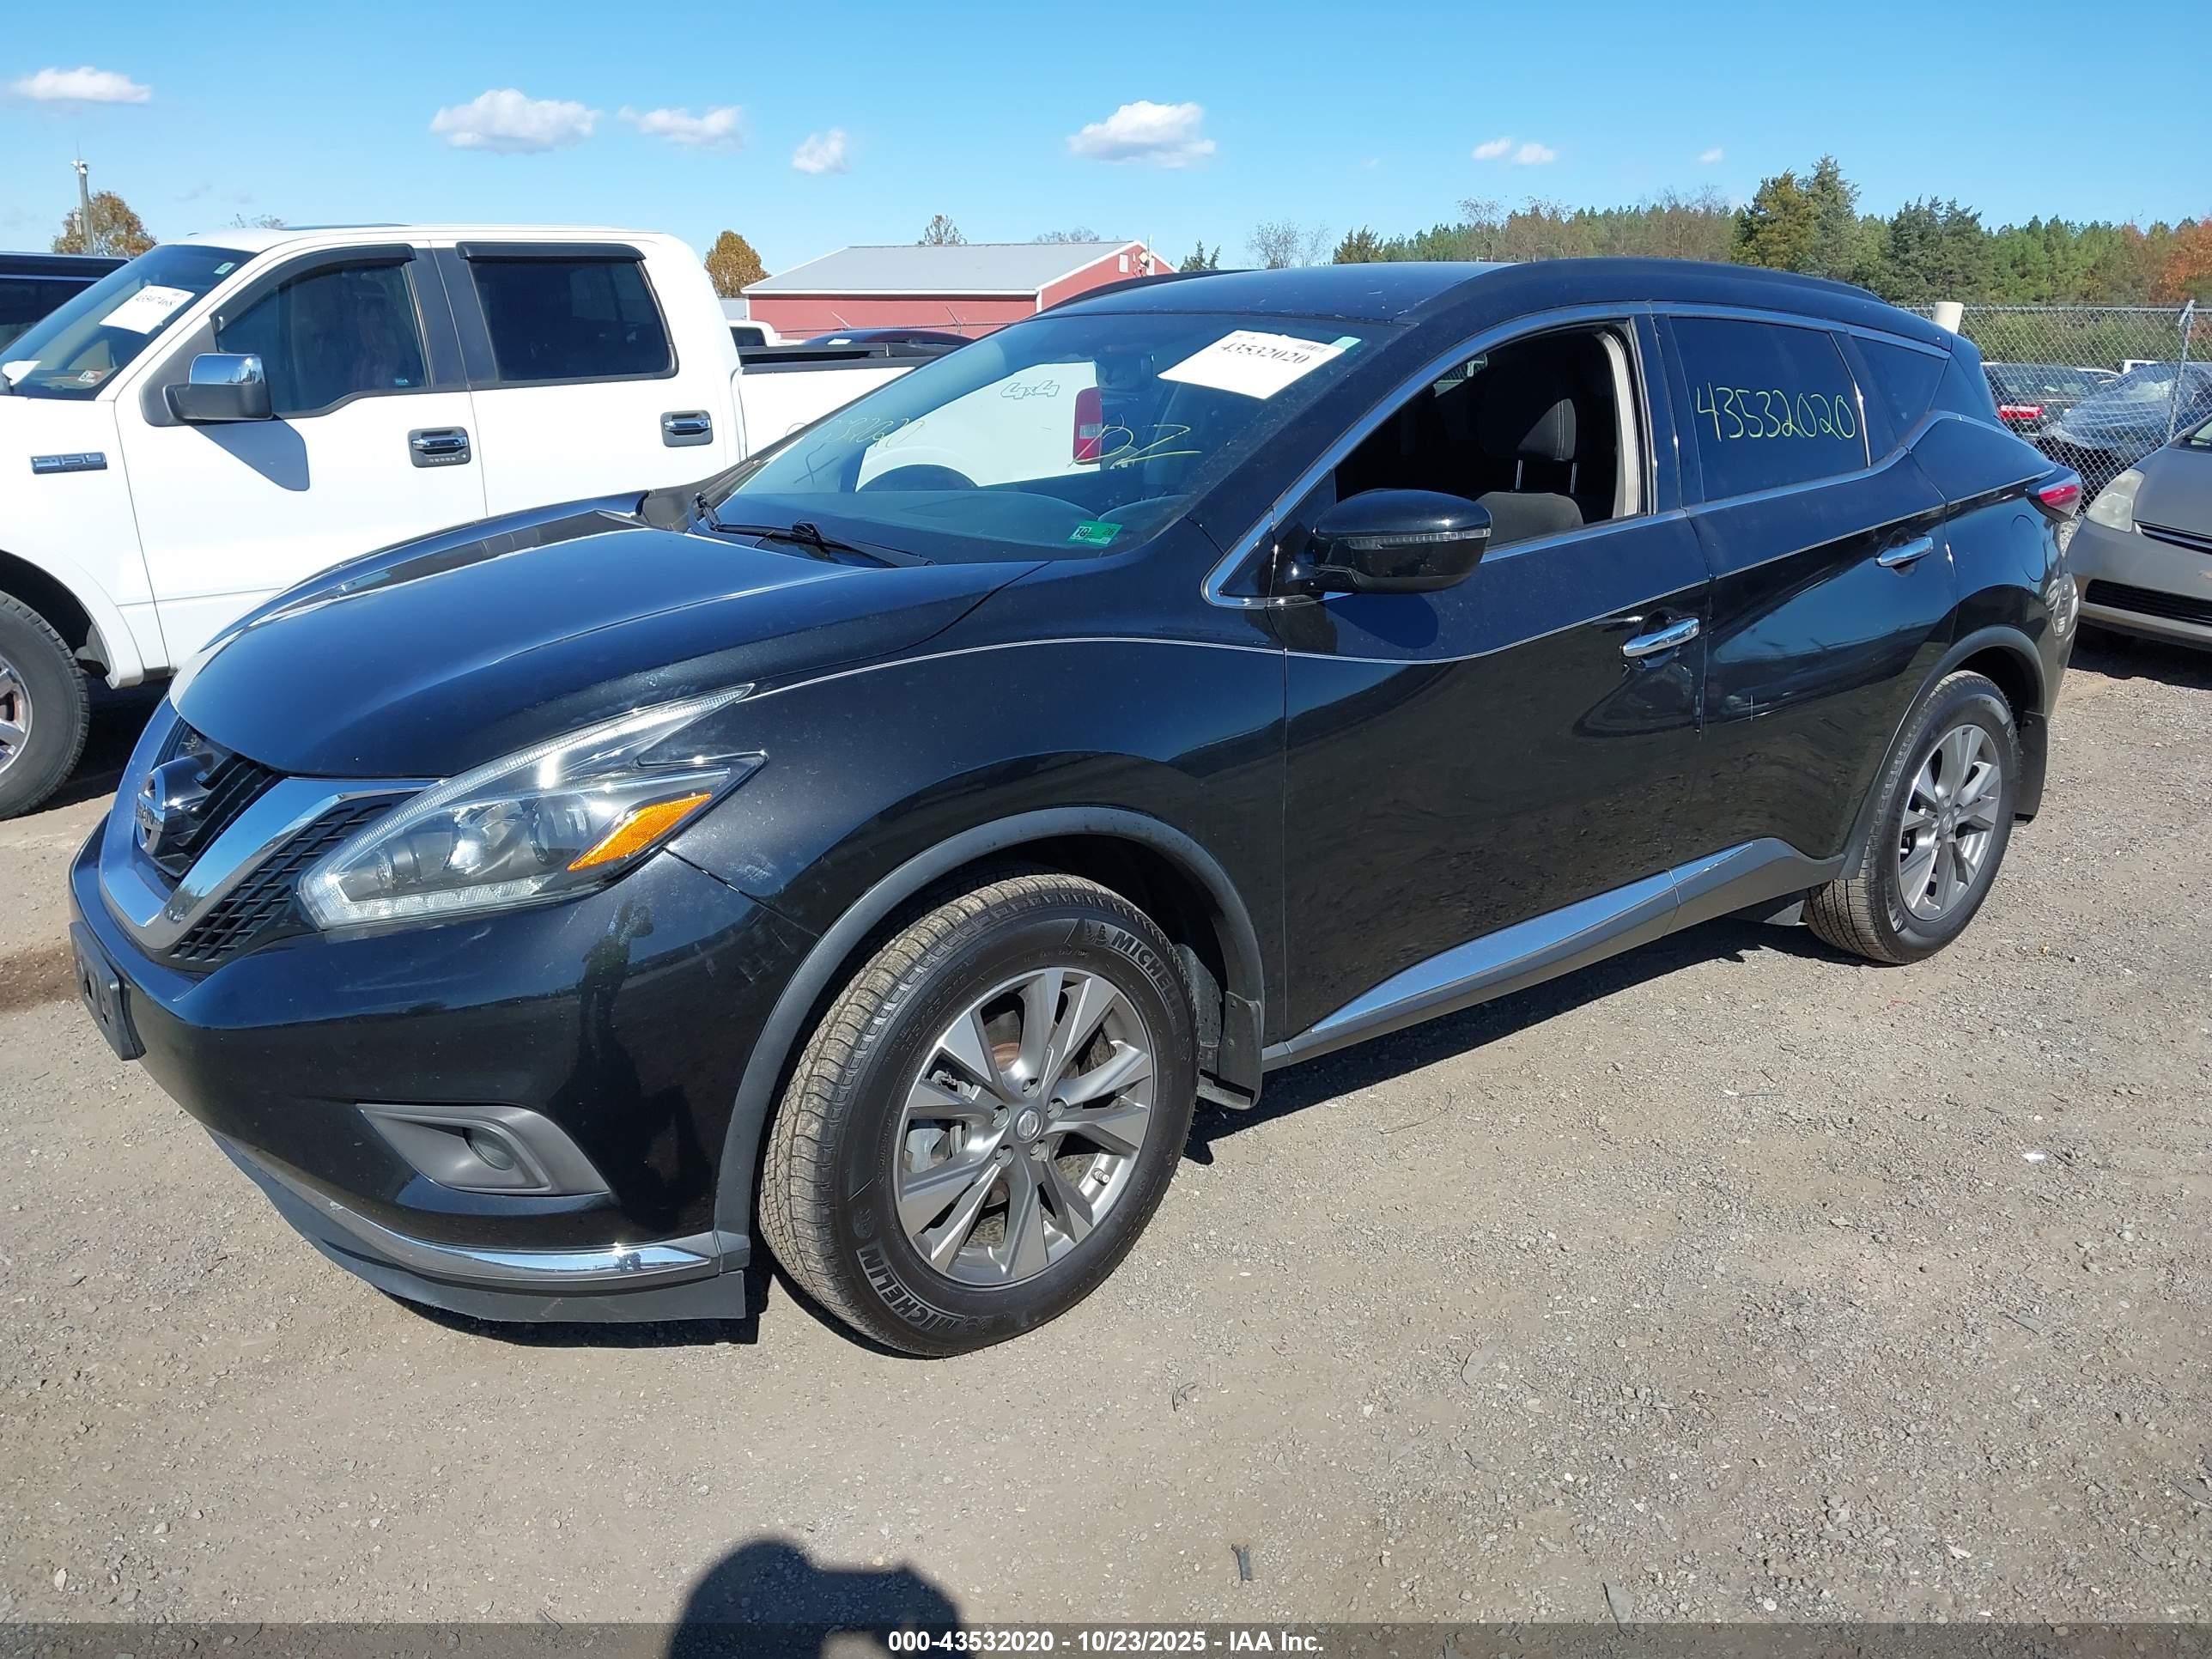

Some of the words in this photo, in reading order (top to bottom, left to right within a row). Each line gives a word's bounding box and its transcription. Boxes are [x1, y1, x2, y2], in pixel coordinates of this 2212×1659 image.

[1221, 343, 1310, 364] 43532020
[1000, 380, 1060, 400] 4x4
[1697, 381, 1856, 442] 43532020
